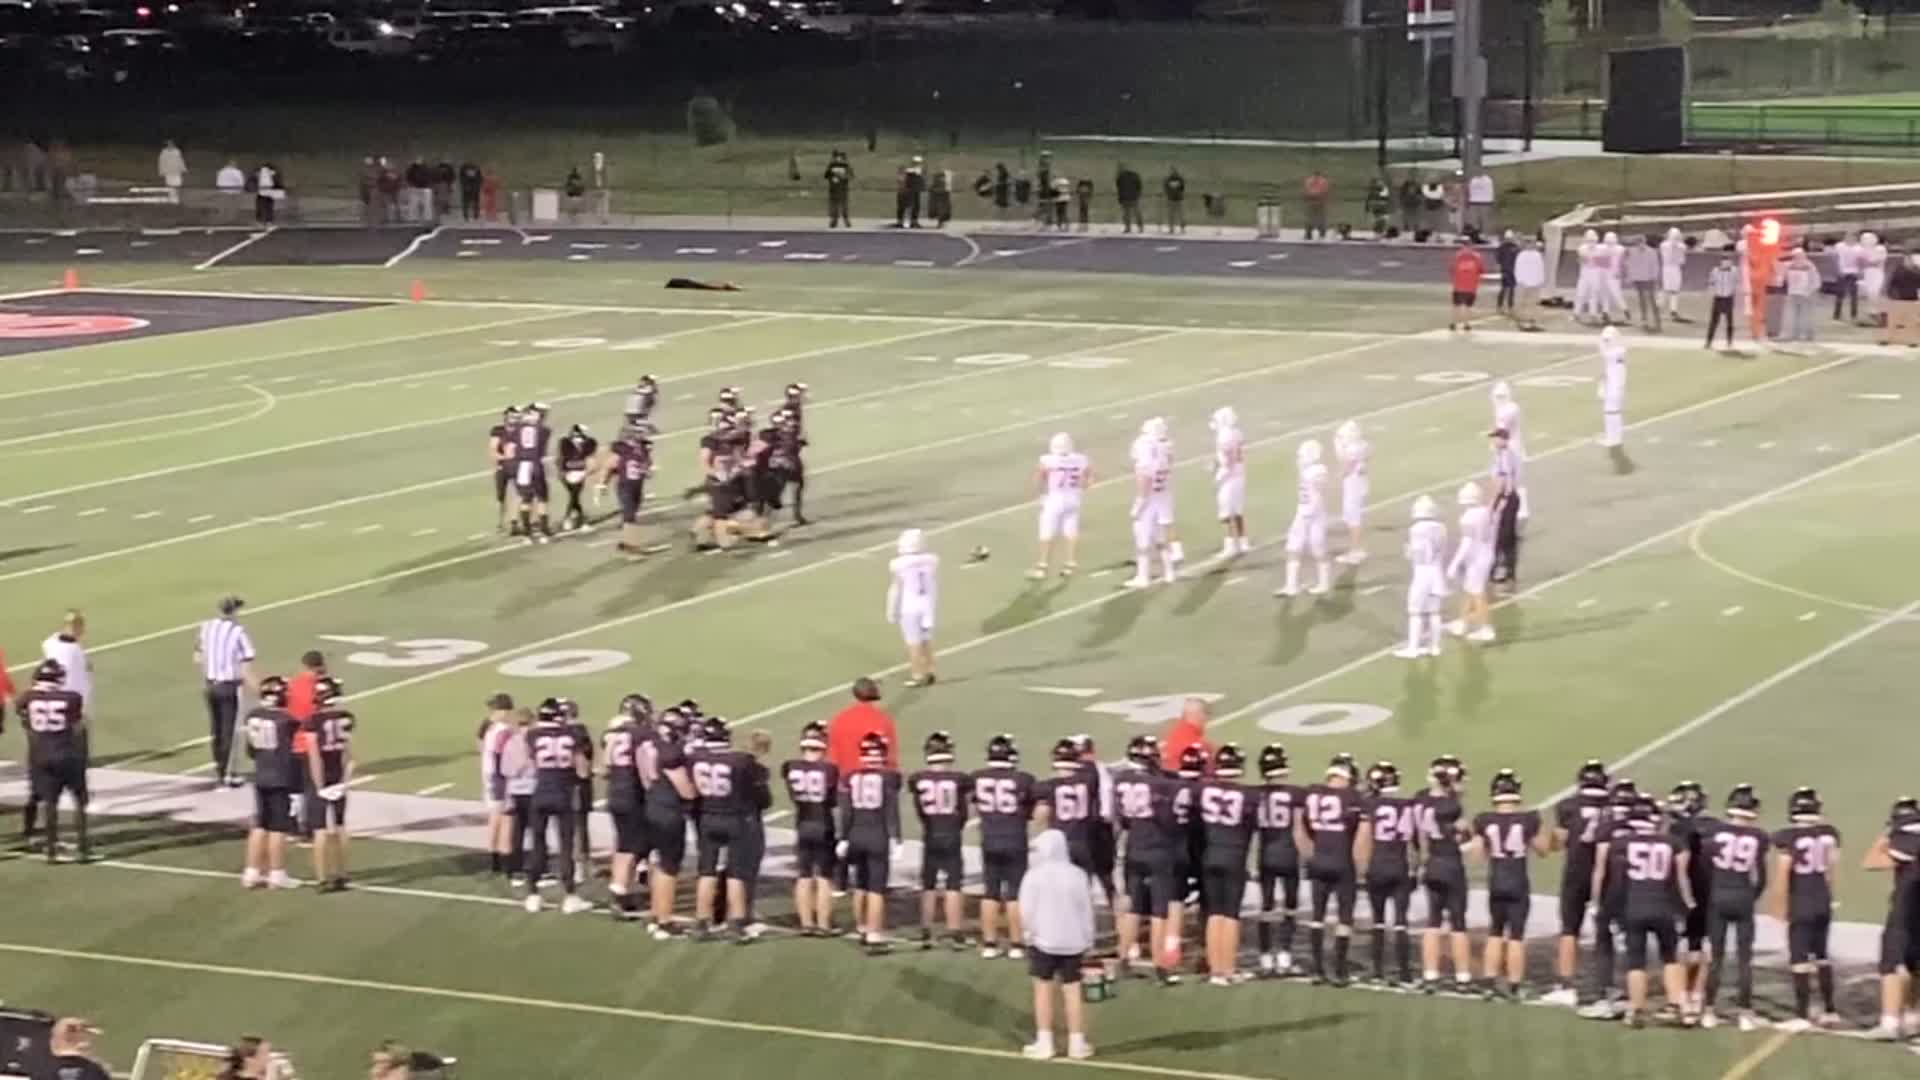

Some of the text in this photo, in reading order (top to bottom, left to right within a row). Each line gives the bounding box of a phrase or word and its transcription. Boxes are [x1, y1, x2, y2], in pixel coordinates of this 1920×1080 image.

[28, 699, 69, 732] 65
[692, 761, 732, 797] 66
[975, 777, 1017, 813] 56
[1201, 787, 1244, 826] 53
[1305, 793, 1345, 832] 12
[1485, 823, 1527, 858] 14
[1711, 831, 1759, 873] 39
[1627, 842, 1672, 880] 50
